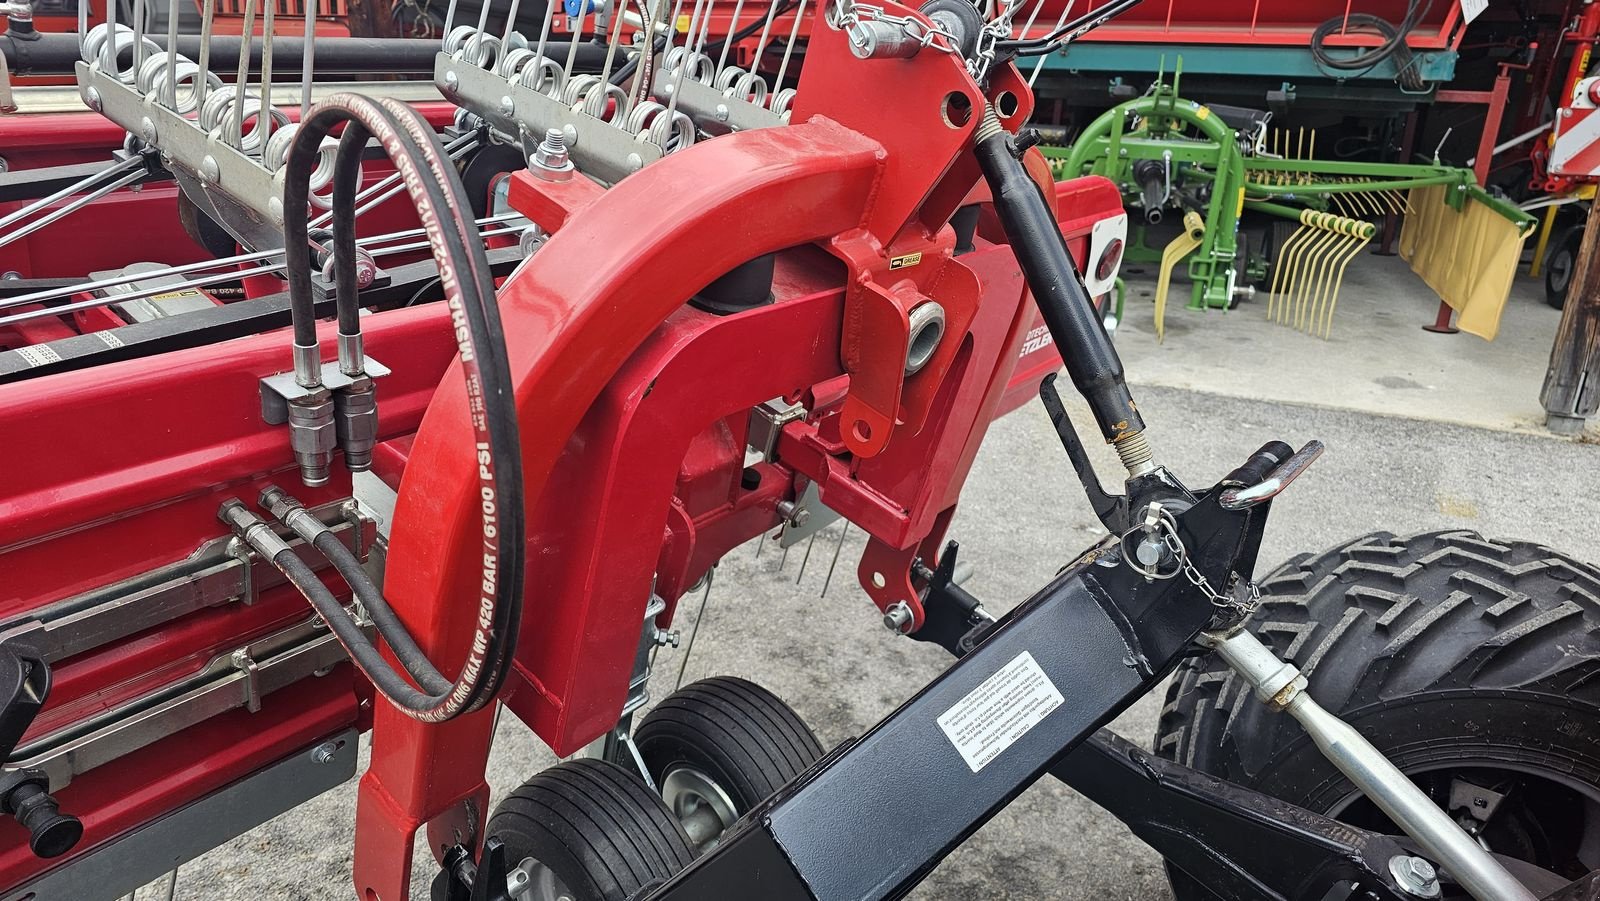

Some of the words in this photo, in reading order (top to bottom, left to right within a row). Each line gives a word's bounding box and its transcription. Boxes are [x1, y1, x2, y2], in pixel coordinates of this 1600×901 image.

[348, 95, 396, 142] ABRASION
[389, 137, 403, 155] &
[396, 152, 424, 199] FRAS
[417, 196, 457, 290] IC-227/12
[904, 255, 919, 264] GREASE
[448, 292, 475, 362] MSHA
[476, 442, 493, 480] PSI
[481, 486, 497, 538] 6100
[483, 540, 497, 551] /
[482, 553, 497, 595] BAR
[479, 597, 494, 630] 420
[472, 629, 488, 655] WP
[463, 653, 482, 685] MAX
